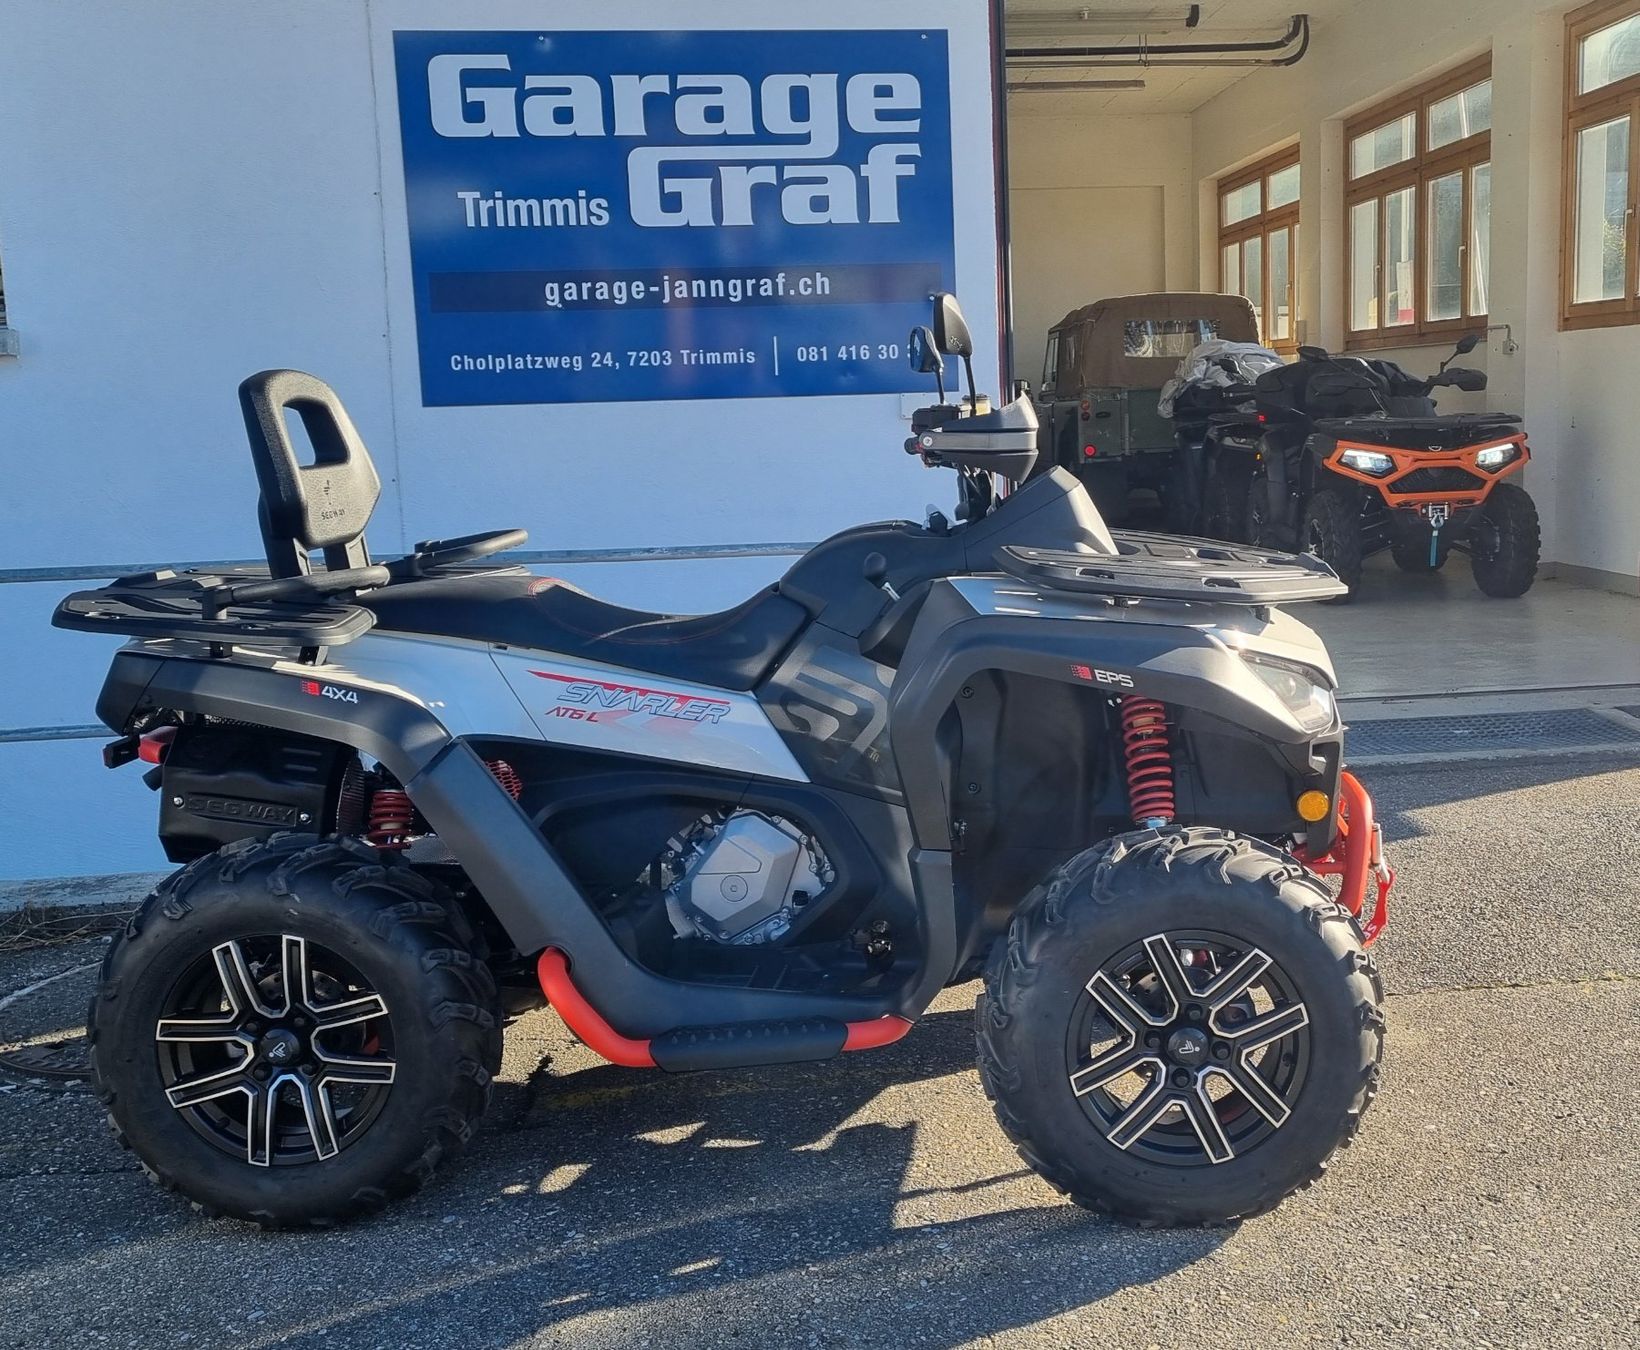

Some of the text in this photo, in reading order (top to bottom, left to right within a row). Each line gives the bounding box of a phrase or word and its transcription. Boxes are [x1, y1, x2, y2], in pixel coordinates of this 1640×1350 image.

[427, 53, 922, 159] Garage
[626, 143, 922, 227] Graf
[456, 189, 610, 227] Trimmis
[544, 271, 831, 306] garage-janngraf.ch
[450, 348, 756, 373] Cholplatzweg 24, 7203 Trimmis
[796, 346, 828, 362] 081
[837, 344, 870, 361] 416
[877, 343, 899, 360] 30
[1094, 668, 1134, 688] EPS
[556, 681, 732, 724] SNARLER
